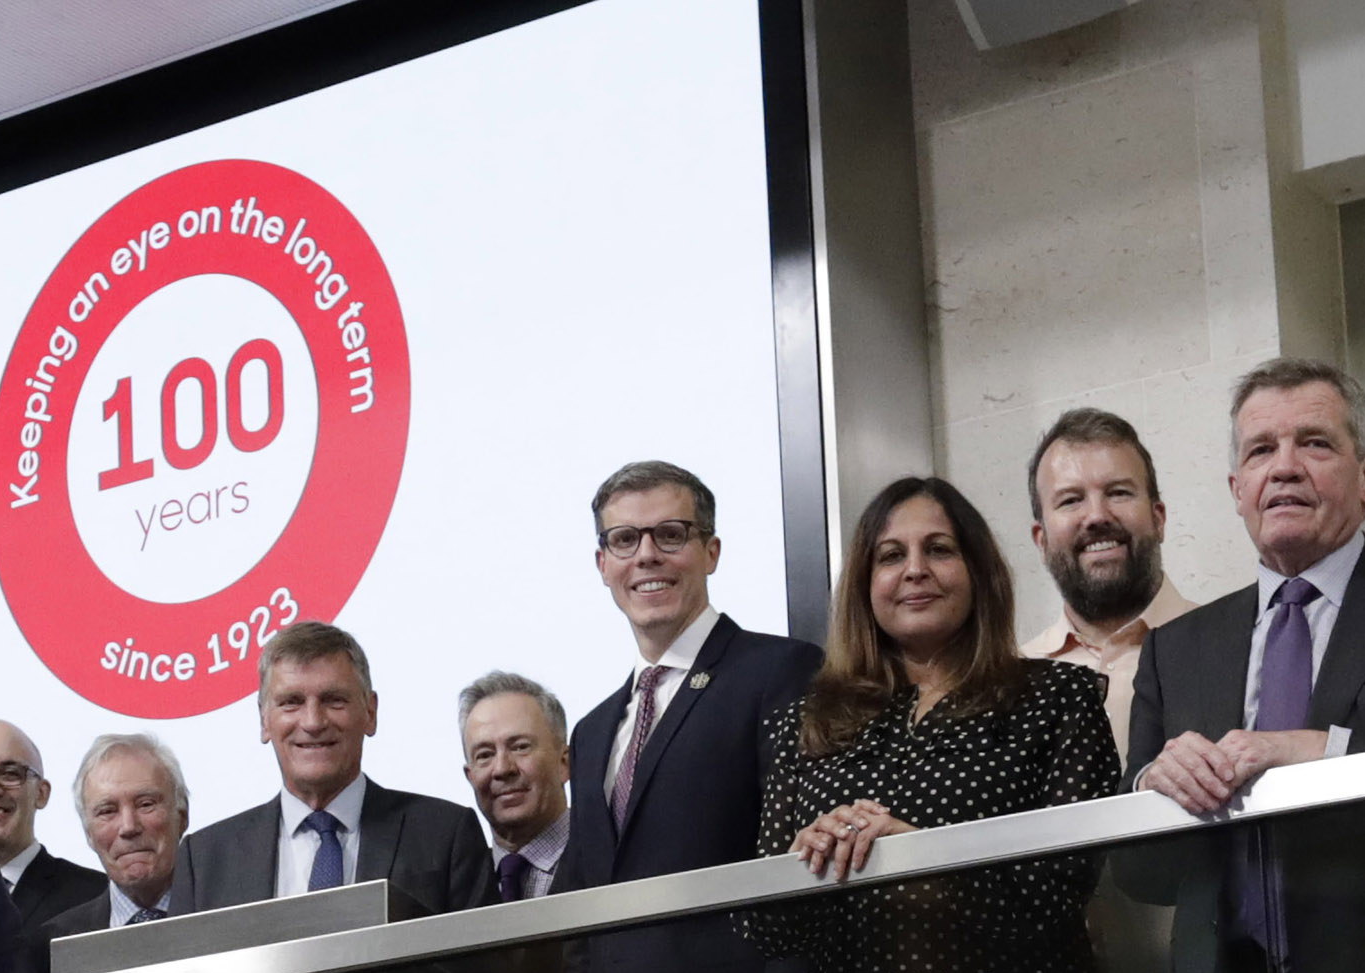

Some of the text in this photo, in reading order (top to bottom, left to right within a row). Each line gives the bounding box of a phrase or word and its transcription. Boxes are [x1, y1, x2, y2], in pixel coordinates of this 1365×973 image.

[9, 196, 375, 509] Keeping an eye on the long term
[98, 337, 285, 492] 100
[134, 480, 251, 552] years
[100, 586, 299, 682] since 1923
